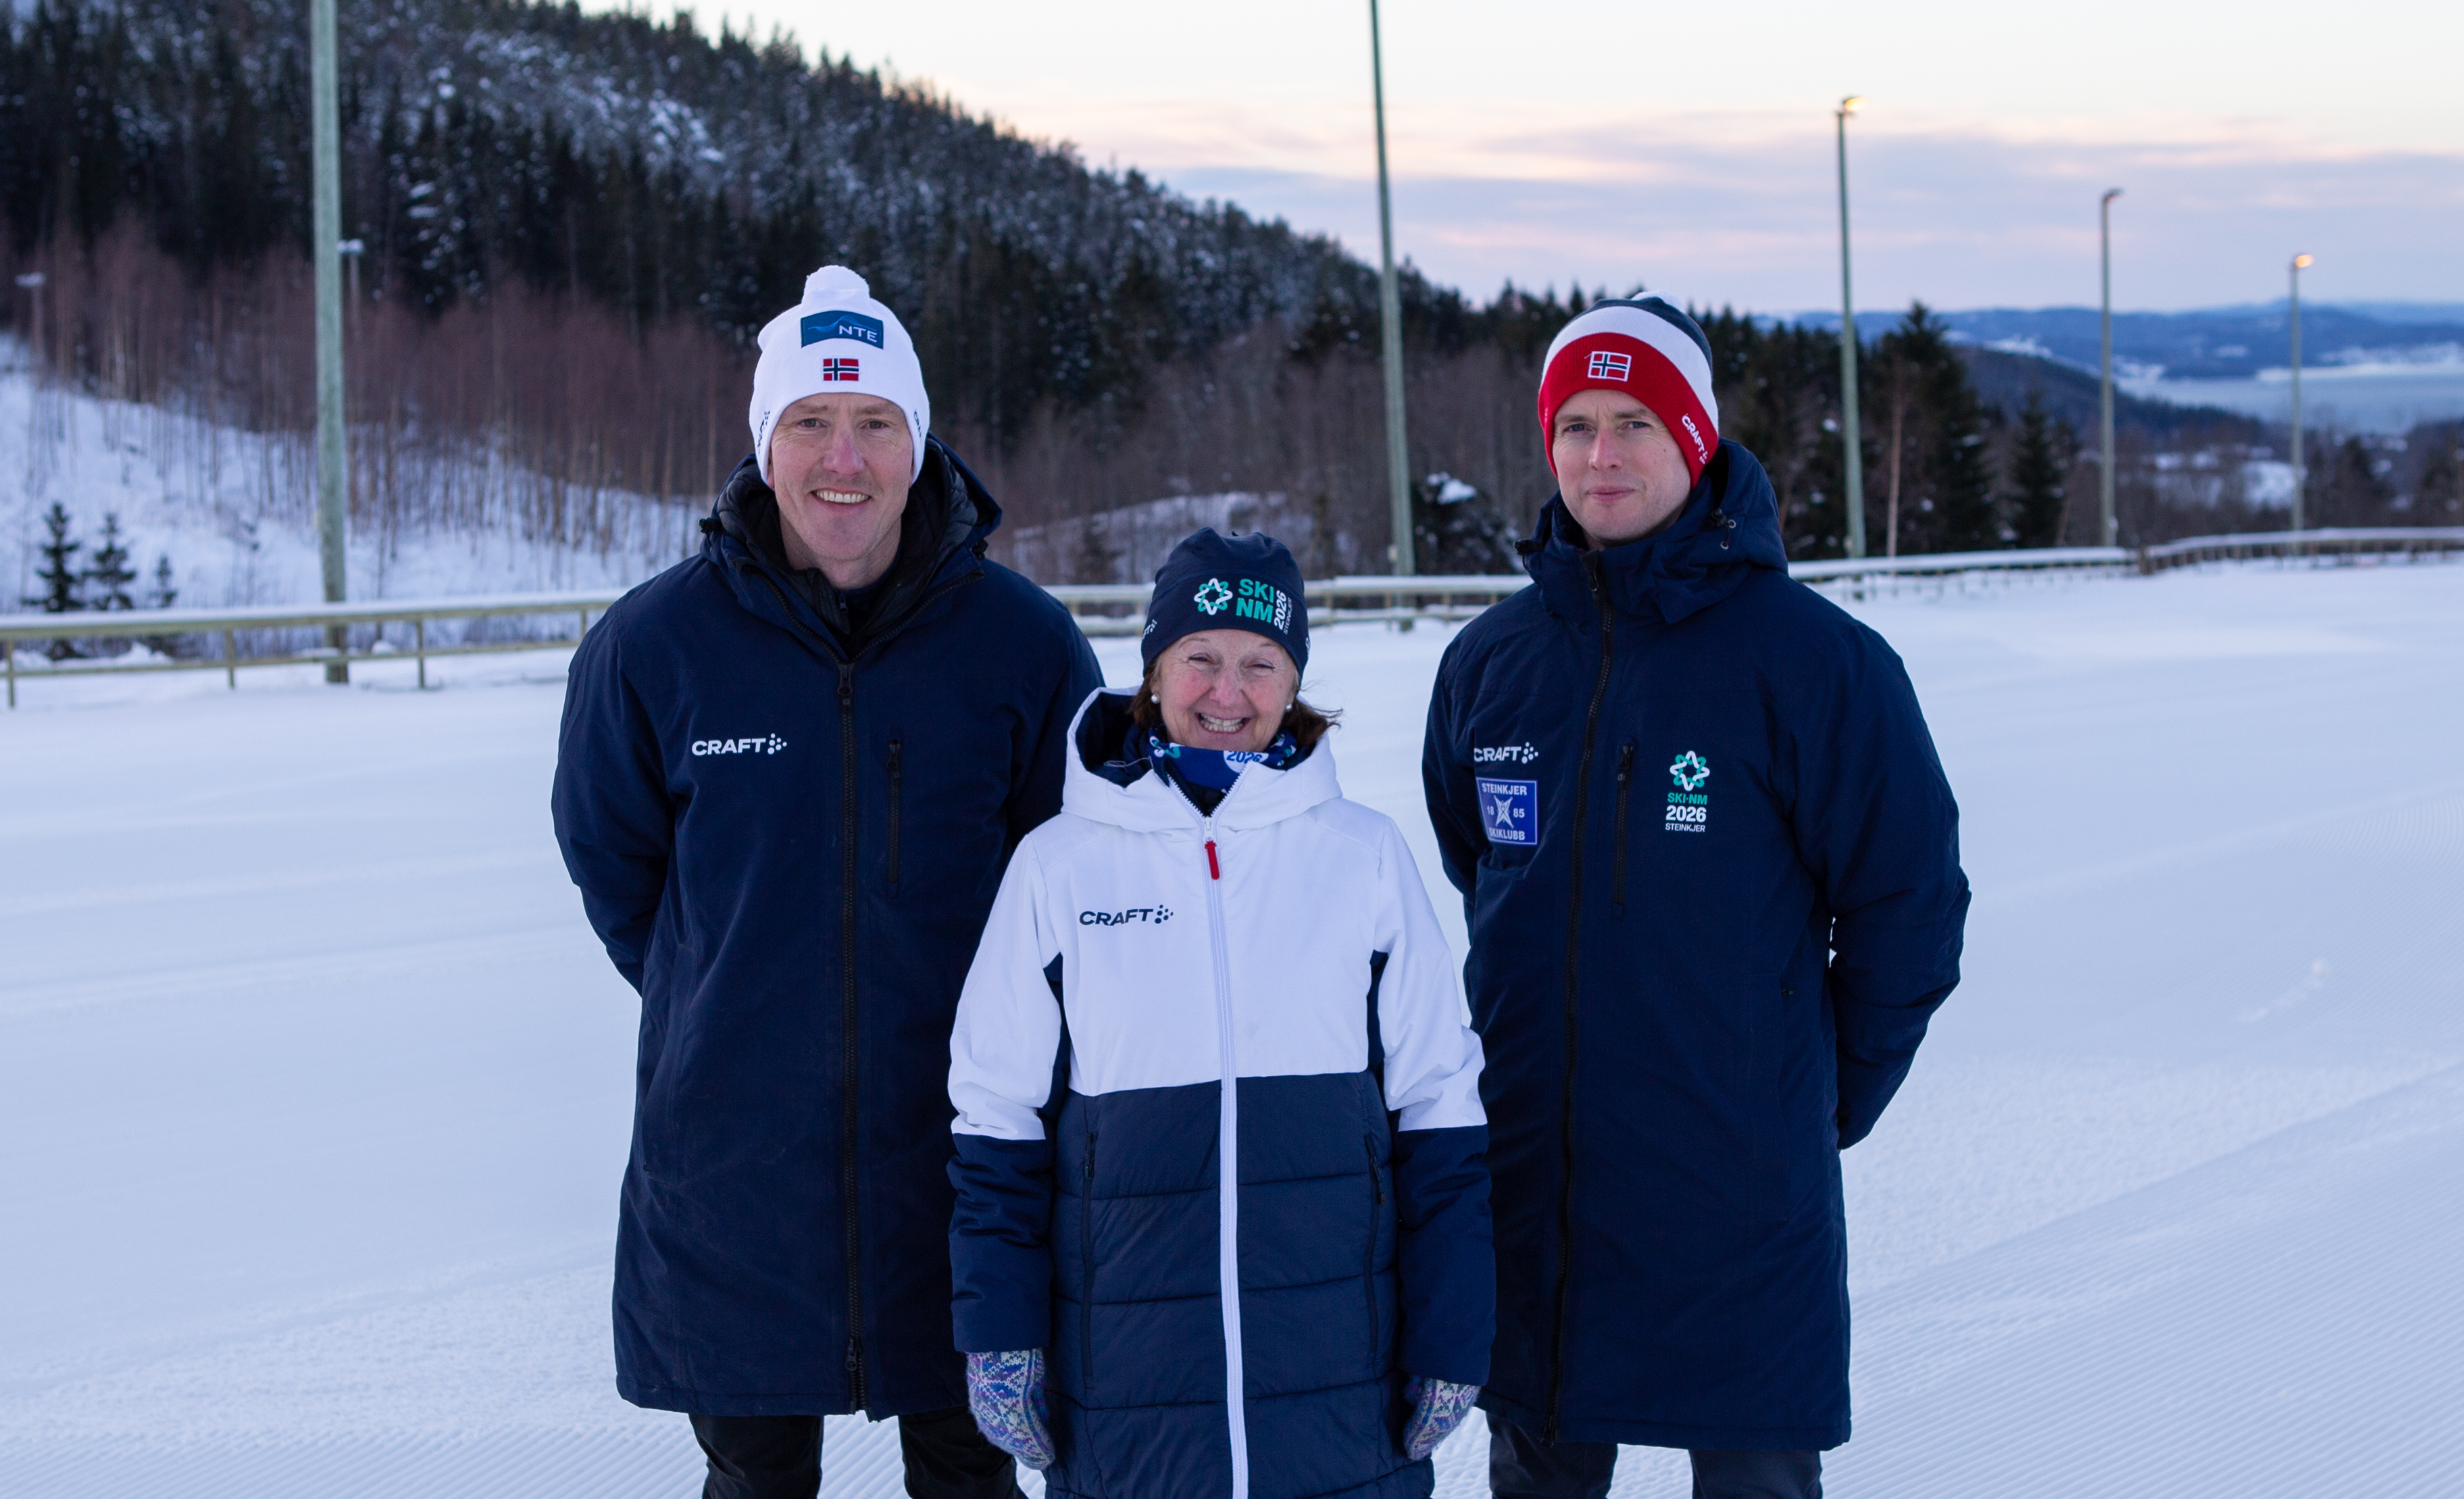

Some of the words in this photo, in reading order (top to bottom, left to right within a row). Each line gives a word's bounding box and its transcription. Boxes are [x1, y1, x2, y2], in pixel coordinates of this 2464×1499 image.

[839, 325, 877, 342] NTE
[1681, 414, 1705, 453] CRAFT
[1238, 578, 1274, 603] SKI
[1236, 597, 1274, 623] NM
[1274, 590, 1287, 630] 2026
[1283, 597, 1292, 635] STEINKJER
[692, 738, 766, 756] CRAFT
[1474, 746, 1522, 762] CRAFT
[1226, 751, 1263, 764] 2026
[1482, 782, 1528, 796] STEINKJER
[1486, 805, 1494, 815] 18
[1513, 808, 1525, 818] 85
[1665, 805, 1707, 823] 2026
[1489, 827, 1526, 841] SKIKLUBB
[1665, 822, 1706, 833] STEINKJER
[1079, 909, 1154, 926] CRAFT
